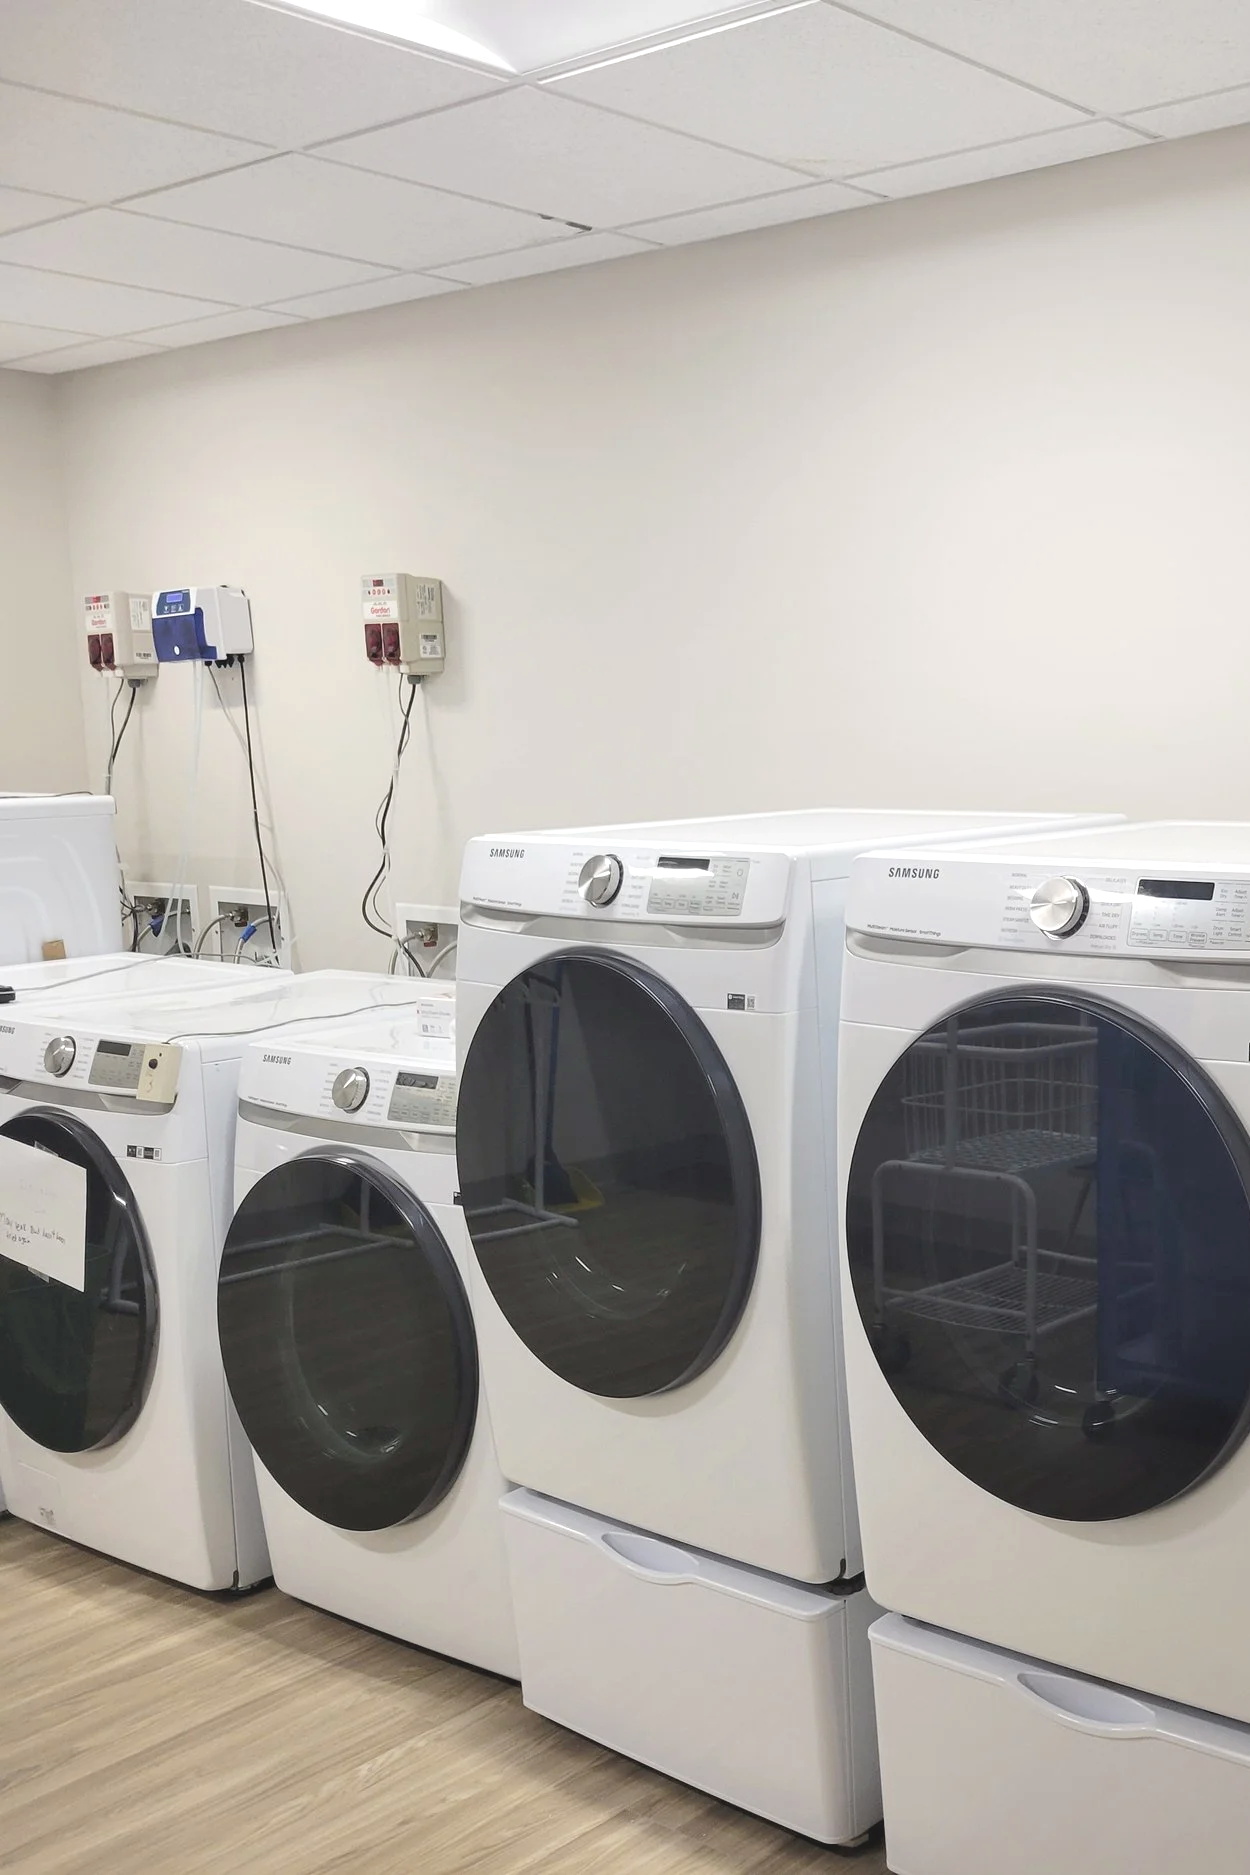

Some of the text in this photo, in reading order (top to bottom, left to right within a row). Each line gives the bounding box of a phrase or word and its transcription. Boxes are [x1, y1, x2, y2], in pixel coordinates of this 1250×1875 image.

[490, 848, 525, 858] SAMSUNG
[888, 867, 940, 879] SAMSUNG
[263, 1054, 292, 1065] SAMSUNG
